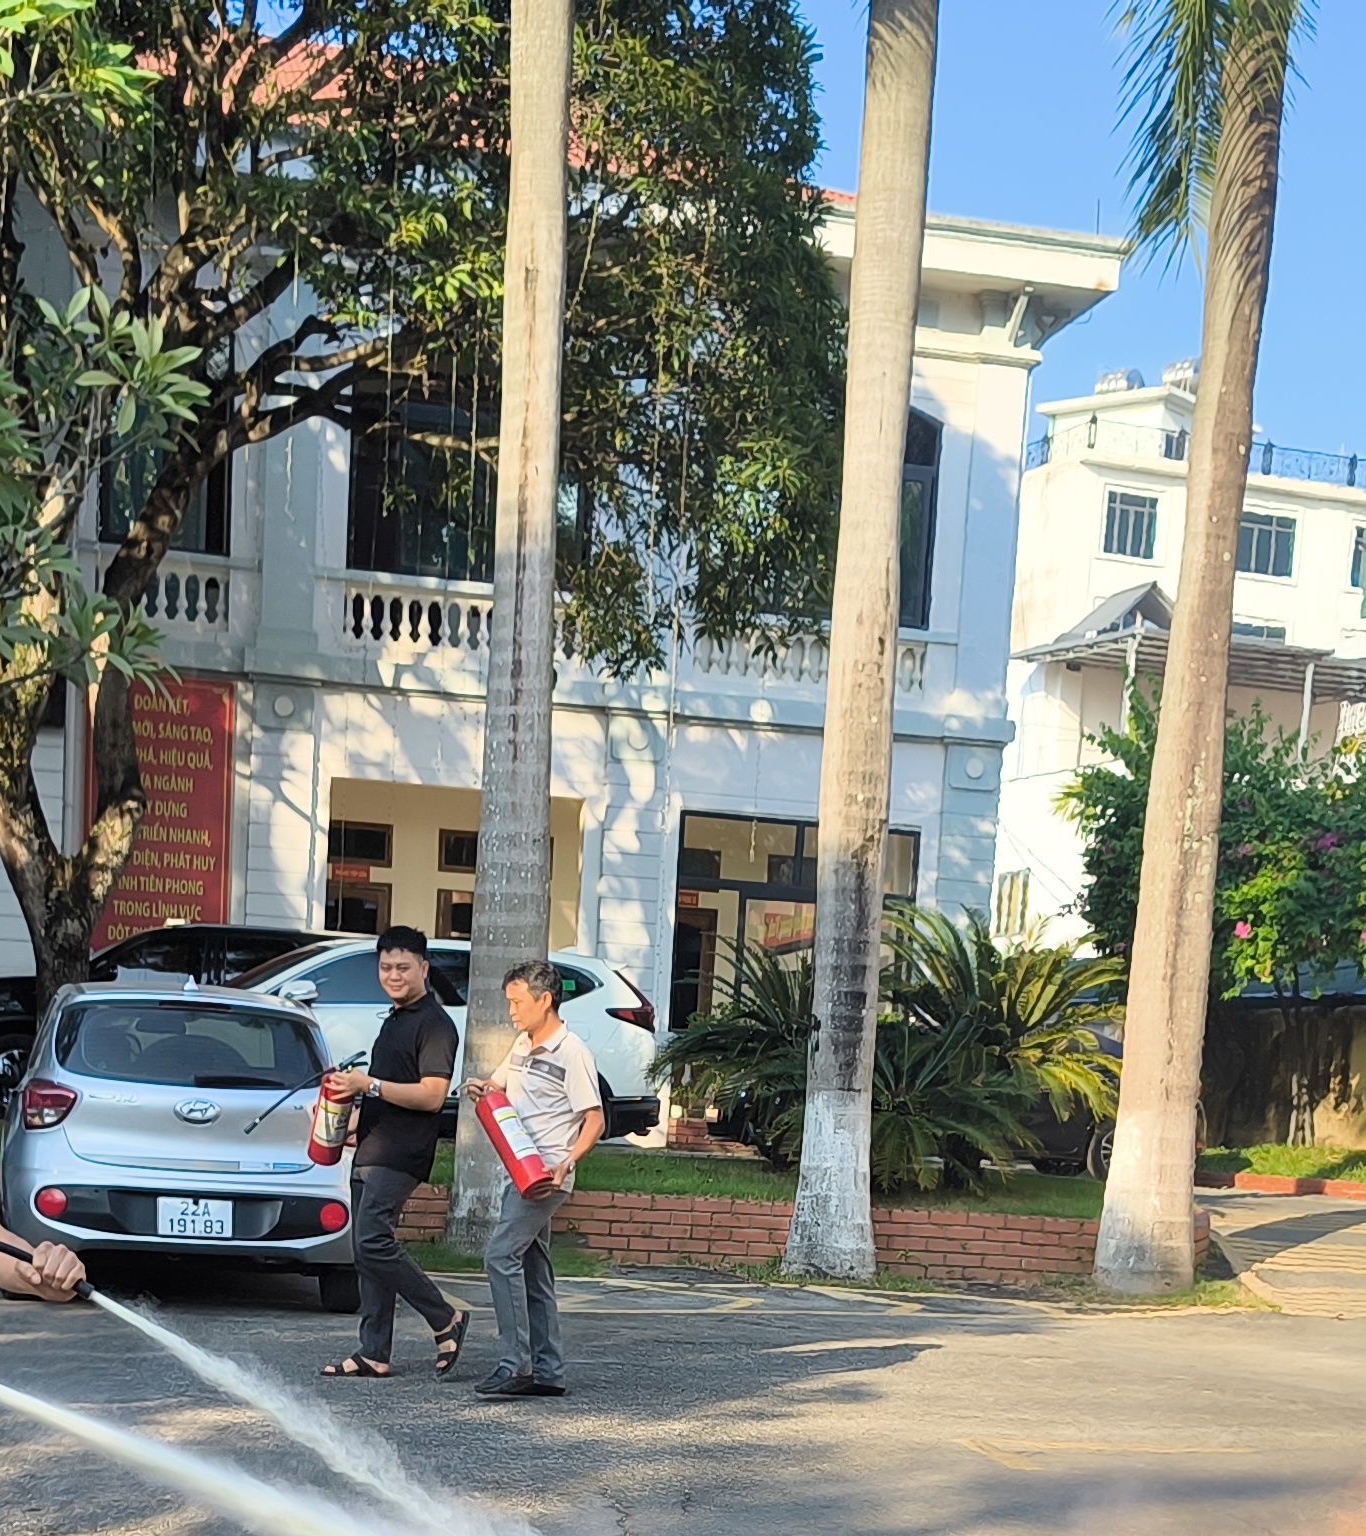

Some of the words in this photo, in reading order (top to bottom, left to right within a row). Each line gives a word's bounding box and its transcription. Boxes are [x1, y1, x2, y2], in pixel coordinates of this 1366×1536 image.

[157, 720, 189, 741] SÁNG
[190, 725, 214, 747] TẠO,
[159, 746, 186, 769] HIỆU
[153, 771, 194, 794] NGÀNH
[155, 797, 188, 821] DỰNG
[168, 827, 211, 848] NHANH,
[133, 848, 161, 871] DIỆN,
[163, 851, 191, 870] PHÁT
[192, 855, 216, 872] HUY
[139, 873, 164, 894] TIÊN
[164, 877, 204, 896] PHONG
[113, 899, 151, 918] TRONG
[179, 1201, 212, 1218] 22A
[168, 1217, 225, 1236] 191.83
